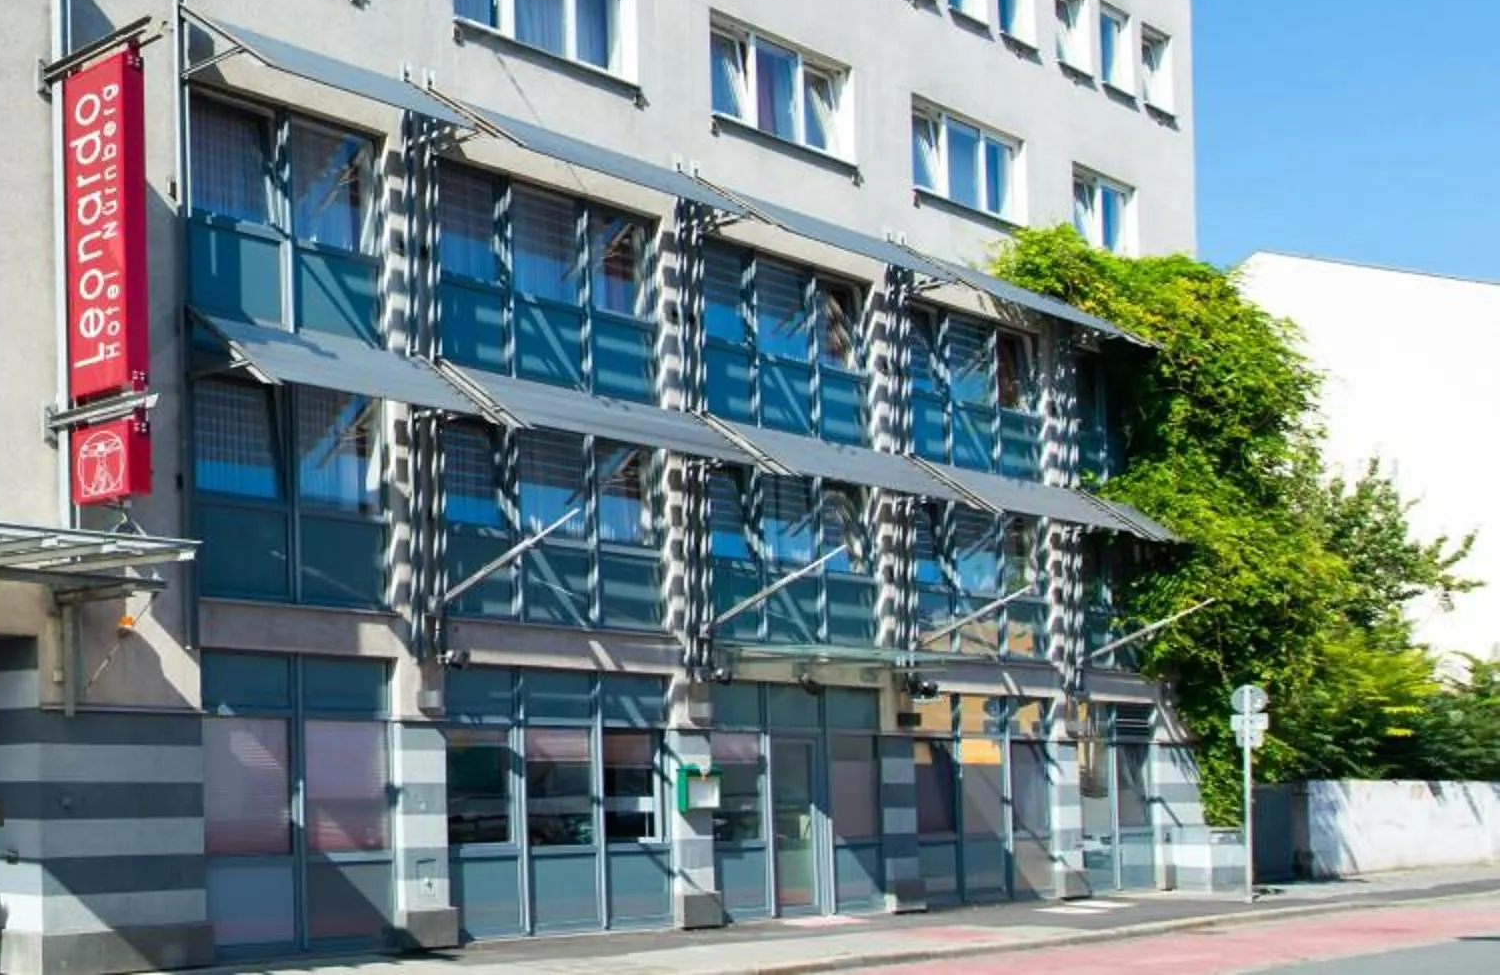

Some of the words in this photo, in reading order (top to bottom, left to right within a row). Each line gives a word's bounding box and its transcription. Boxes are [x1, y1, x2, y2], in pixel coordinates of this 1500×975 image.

[70, 93, 105, 368] Leonardo
[101, 83, 119, 240] Nürnberg
[102, 271, 120, 359] Hotel
